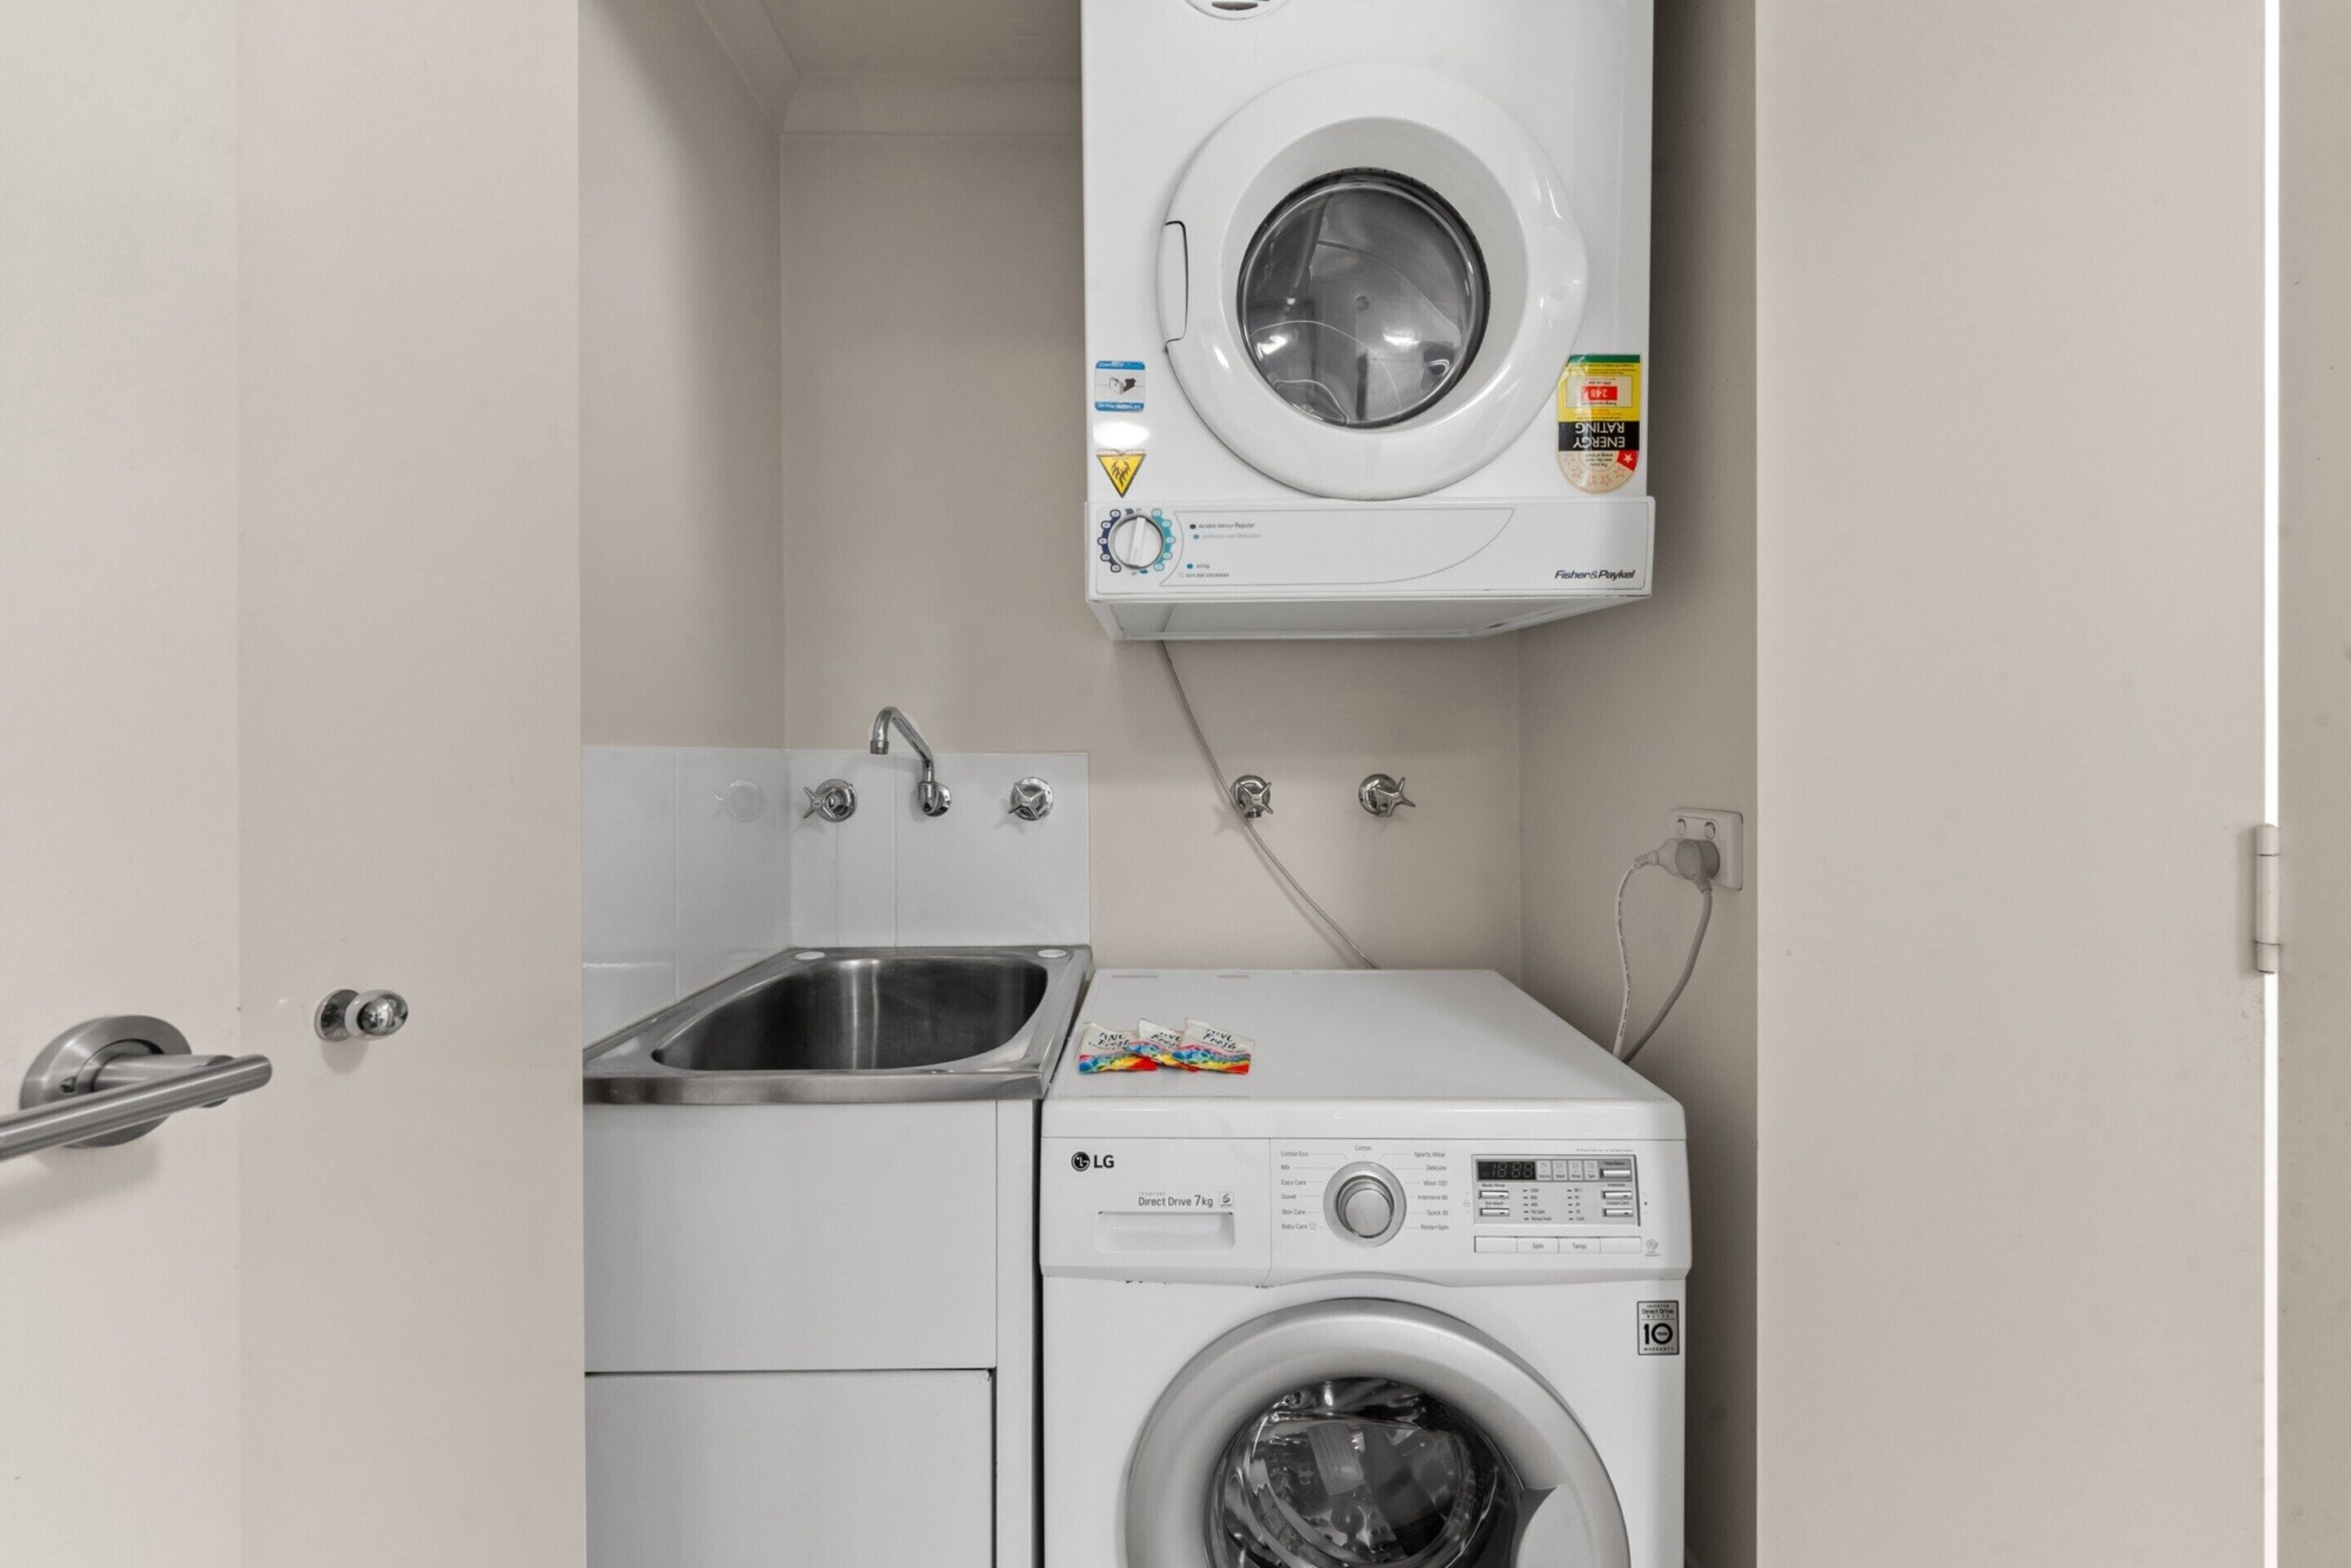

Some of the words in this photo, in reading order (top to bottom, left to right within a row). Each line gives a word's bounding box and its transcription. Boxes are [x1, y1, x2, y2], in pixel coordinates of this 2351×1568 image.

[1591, 388, 1607, 398] 248
[1575, 422, 1624, 433] RATING
[1573, 437, 1624, 448] ENERGY
[1094, 1155, 1115, 1169] LG
[1139, 1197, 1166, 1206] Direct
[1168, 1197, 1192, 1206] Drive
[1643, 1322, 1673, 1345] 10
